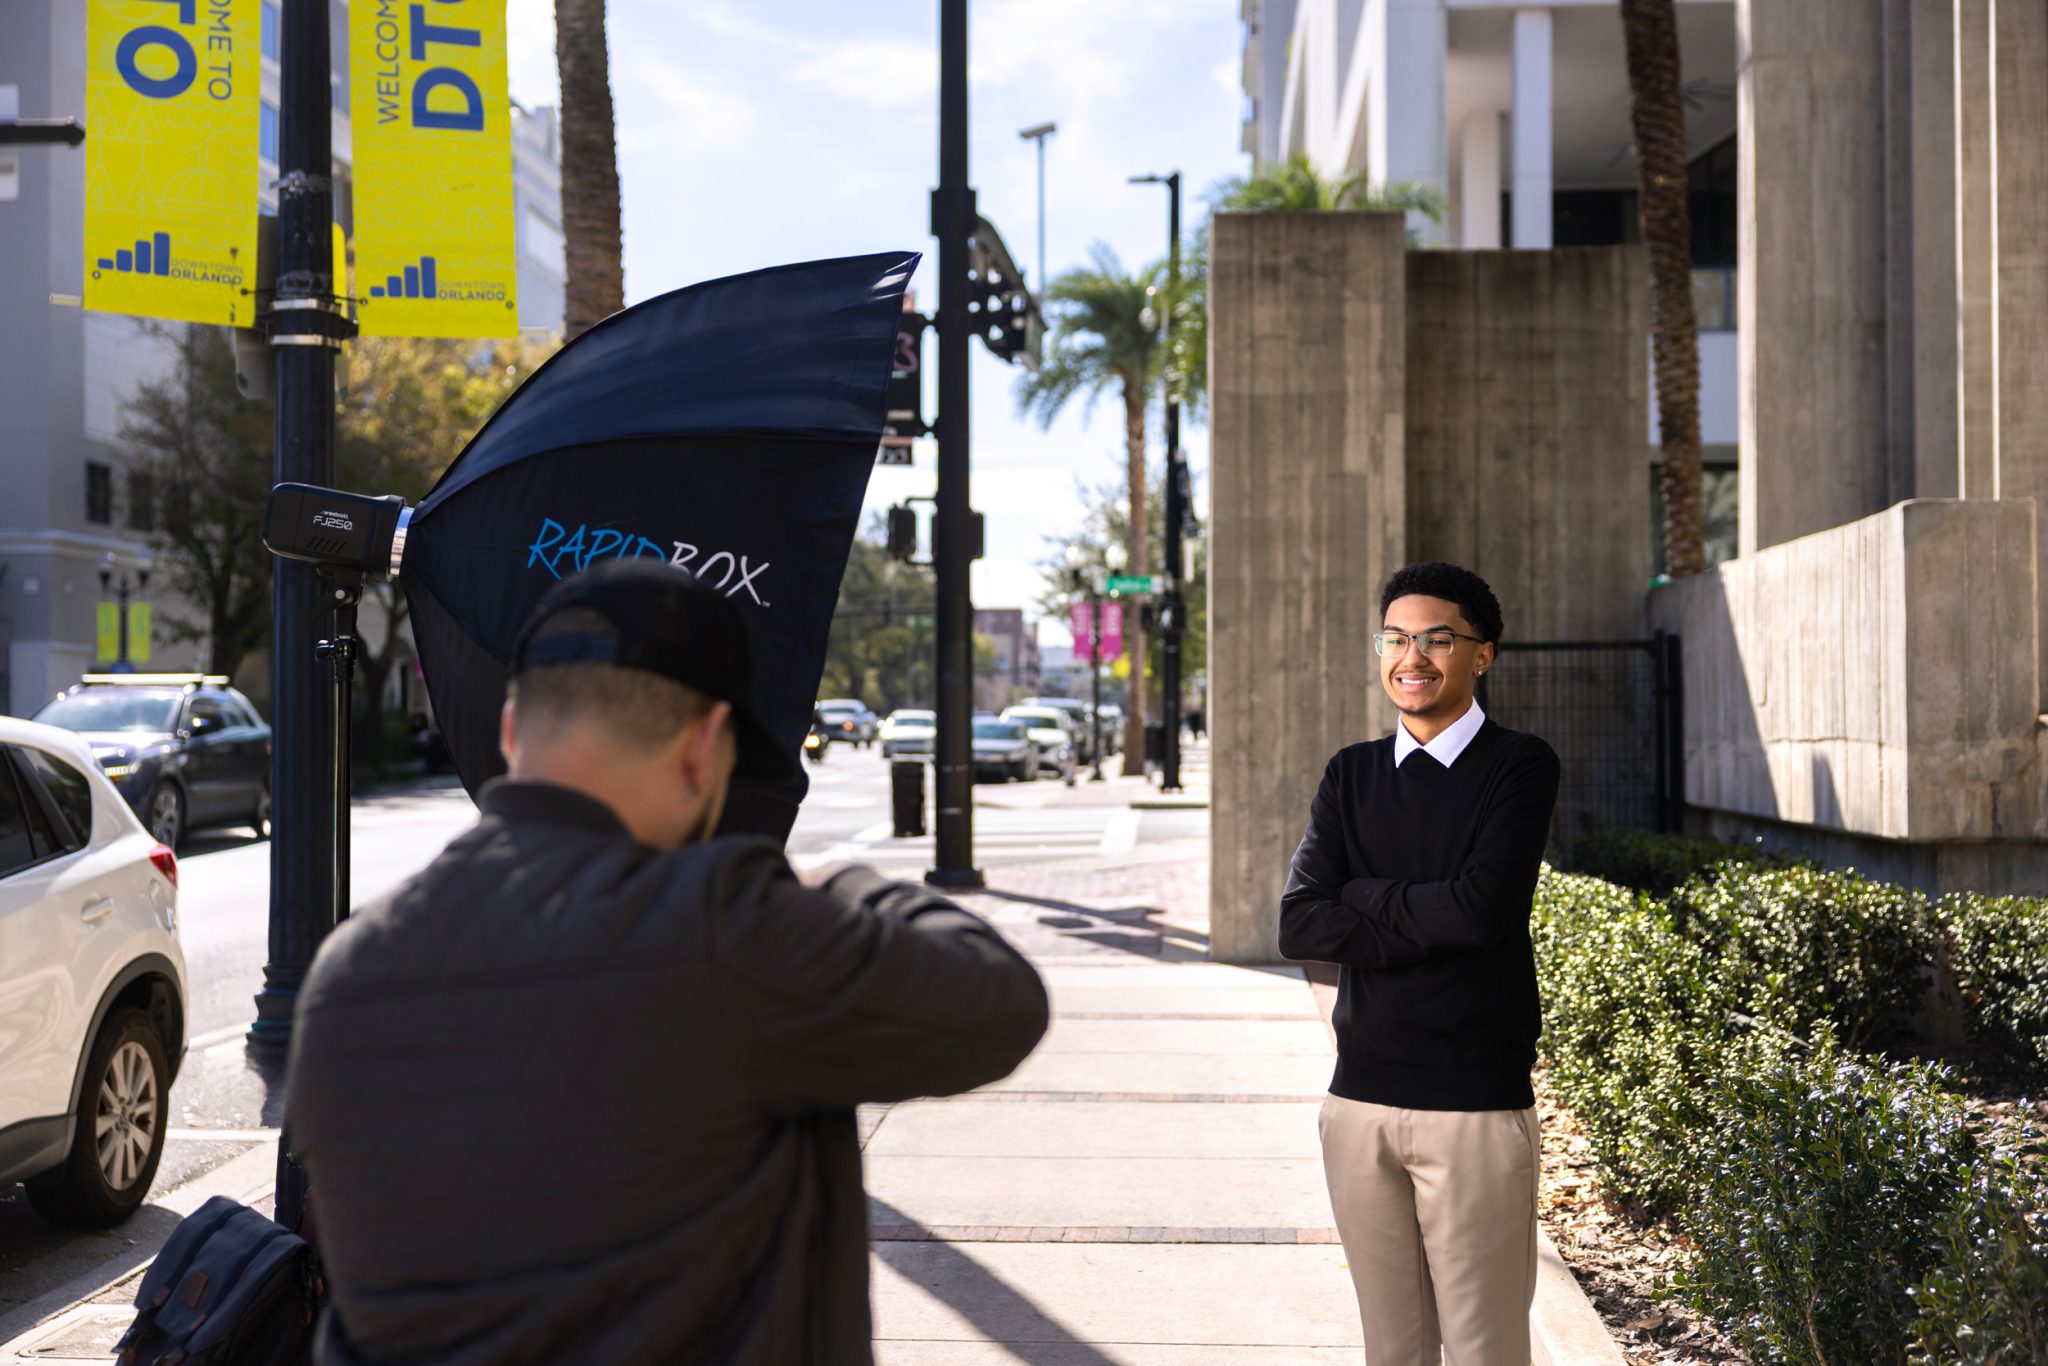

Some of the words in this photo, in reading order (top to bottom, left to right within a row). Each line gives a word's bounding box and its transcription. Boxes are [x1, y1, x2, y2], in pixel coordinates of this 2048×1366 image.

[409, 0, 484, 132] DT
[208, 61, 232, 100] TO
[171, 257, 244, 274] DOWNTOWN
[171, 267, 243, 286] ORLANDO
[438, 280, 506, 289] DOWNTOWN
[438, 289, 506, 301] ORLANDO
[313, 515, 353, 530] FJ250
